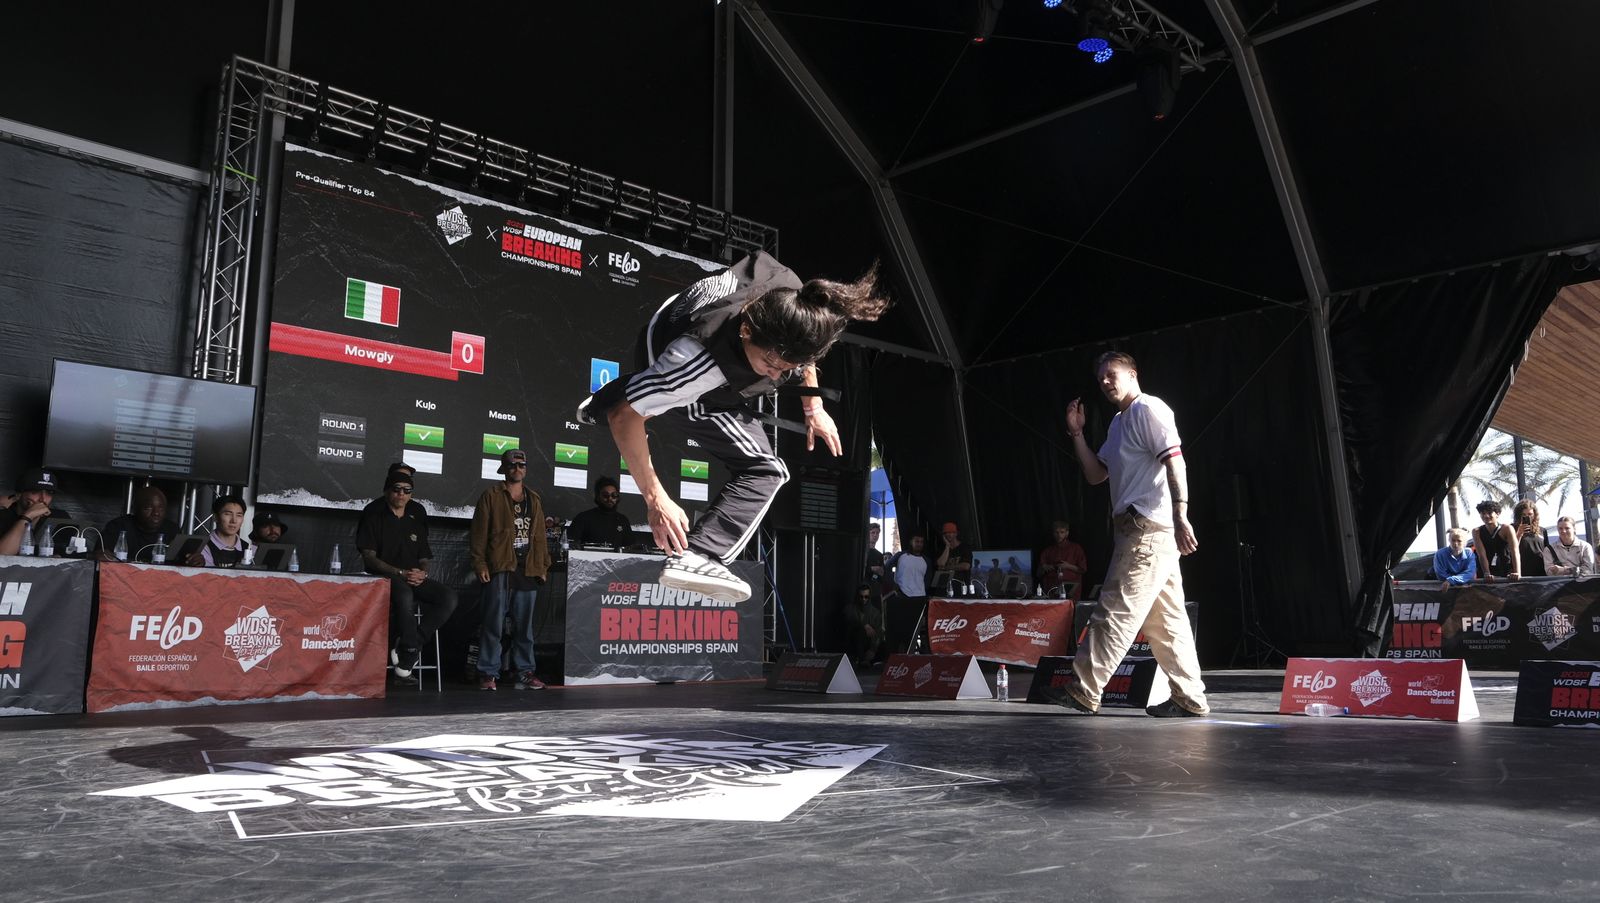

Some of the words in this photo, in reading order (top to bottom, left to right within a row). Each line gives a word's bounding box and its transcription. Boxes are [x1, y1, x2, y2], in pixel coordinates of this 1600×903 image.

[295, 170, 346, 190] Pre-Qualifier
[347, 184, 362, 195] Top
[363, 189, 375, 198] 64
[443, 210, 468, 225] WDSF
[436, 218, 472, 235] BREAKING
[502, 225, 523, 236] WDSF
[523, 224, 583, 251] EUROPEAN
[501, 232, 583, 270] BREAKING
[501, 251, 560, 272] CHAMPIONSHIPS
[561, 266, 582, 277] SPAIN
[344, 344, 394, 365] Mowgly
[461, 343, 475, 364] 0
[600, 368, 610, 387] 0
[415, 399, 437, 411] Kujo
[321, 418, 356, 431] ROUND
[565, 421, 580, 431] Fox
[319, 447, 353, 458] ROUND
[356, 451, 363, 459] 2
[607, 582, 639, 594] 2023
[601, 594, 637, 605] WDSF
[638, 583, 737, 607] EUROP
[236, 616, 277, 635] WDSF
[600, 608, 740, 641] BREAKING
[1535, 614, 1569, 626] WDSF
[303, 624, 320, 636] world
[1014, 629, 1050, 640] DanceSport
[1528, 626, 1576, 634] BREAKING
[224, 634, 282, 647] BREAKING
[301, 637, 355, 651] DanceSport
[600, 643, 703, 655] CHAMPIONSHIPS
[705, 643, 739, 654] SPAIN
[1404, 650, 1442, 658] SPAIN
[167, 653, 198, 662] ESPAÑOLA
[136, 664, 156, 672] BAILE
[156, 664, 190, 672] DEPORTIVO
[1359, 676, 1387, 686] WDSF
[1553, 678, 1588, 687] WDSF
[1350, 684, 1392, 693] BREAKING
[1406, 688, 1456, 698] DanceSport
